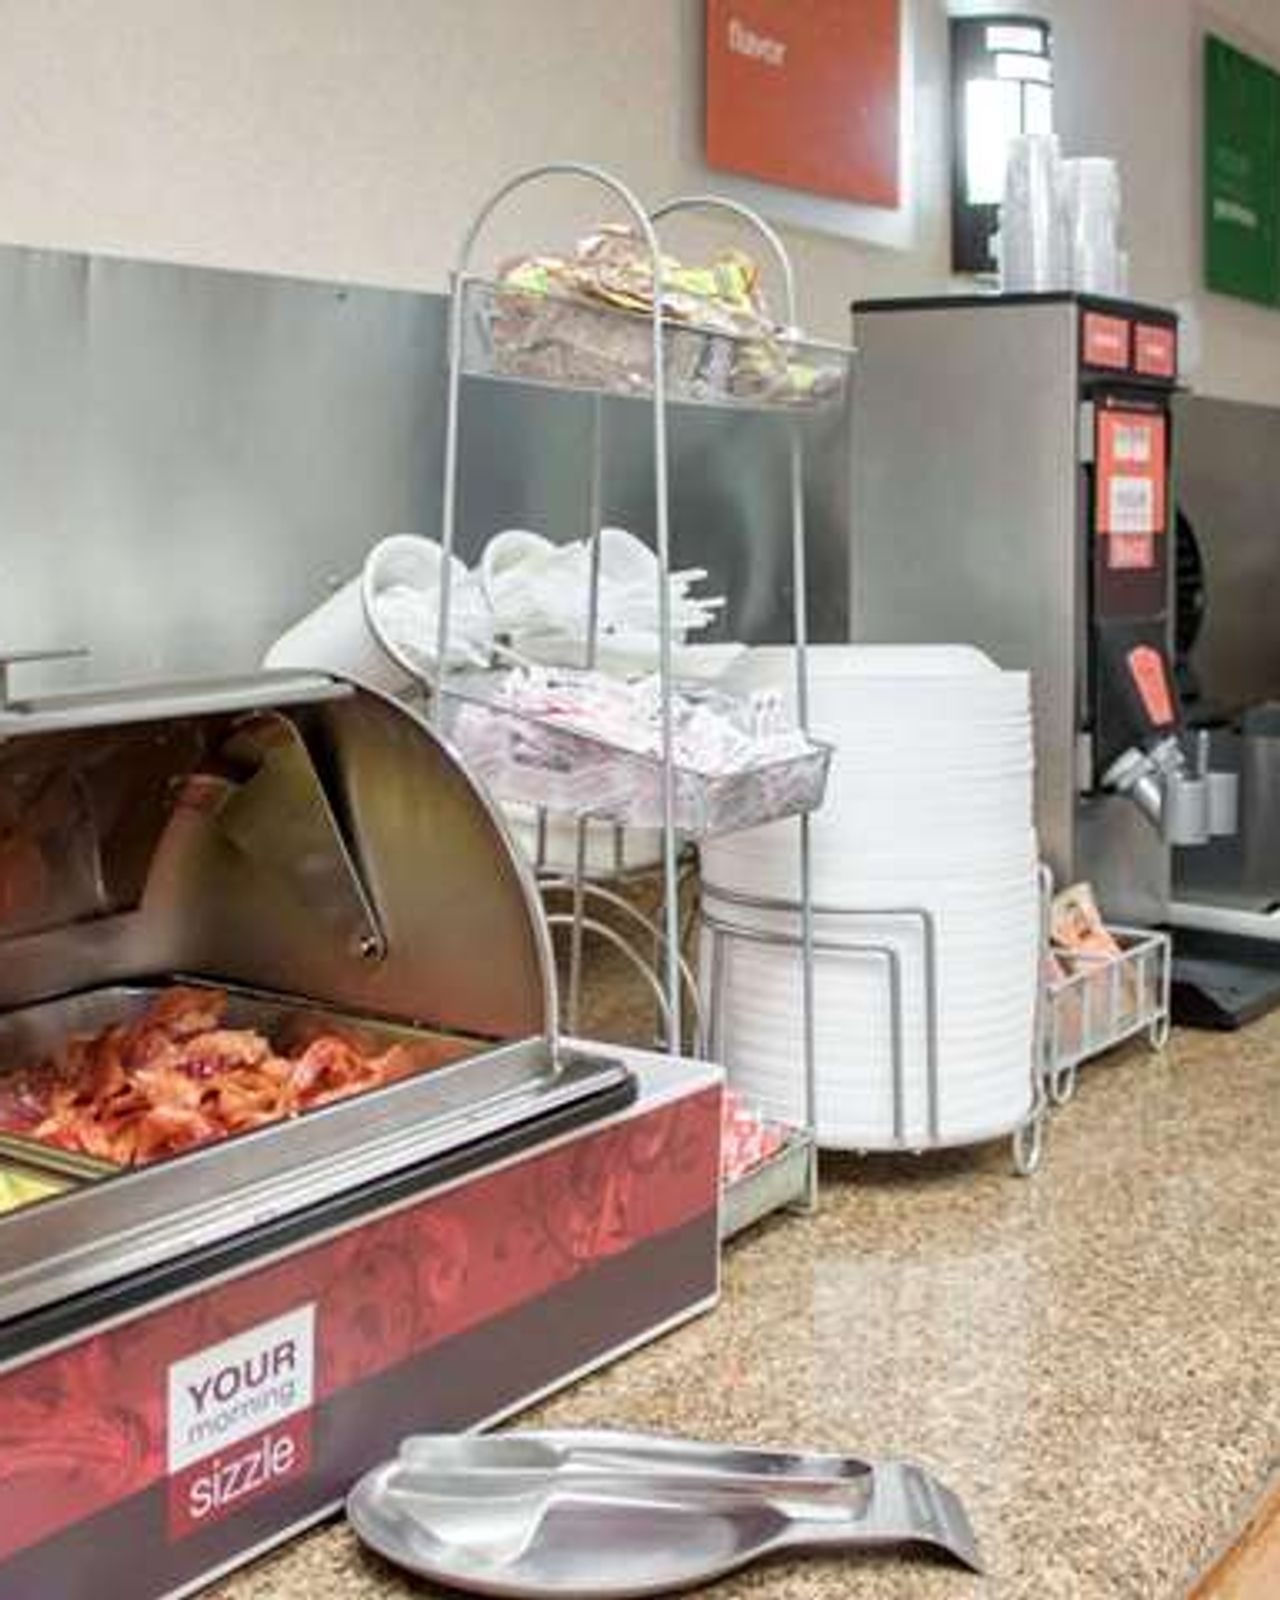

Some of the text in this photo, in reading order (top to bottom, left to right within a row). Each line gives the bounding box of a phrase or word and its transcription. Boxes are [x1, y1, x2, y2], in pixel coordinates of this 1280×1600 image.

[188, 1340, 296, 1414] YOUR
[188, 1381, 296, 1443] morning
[189, 1433, 295, 1518] sizzle
